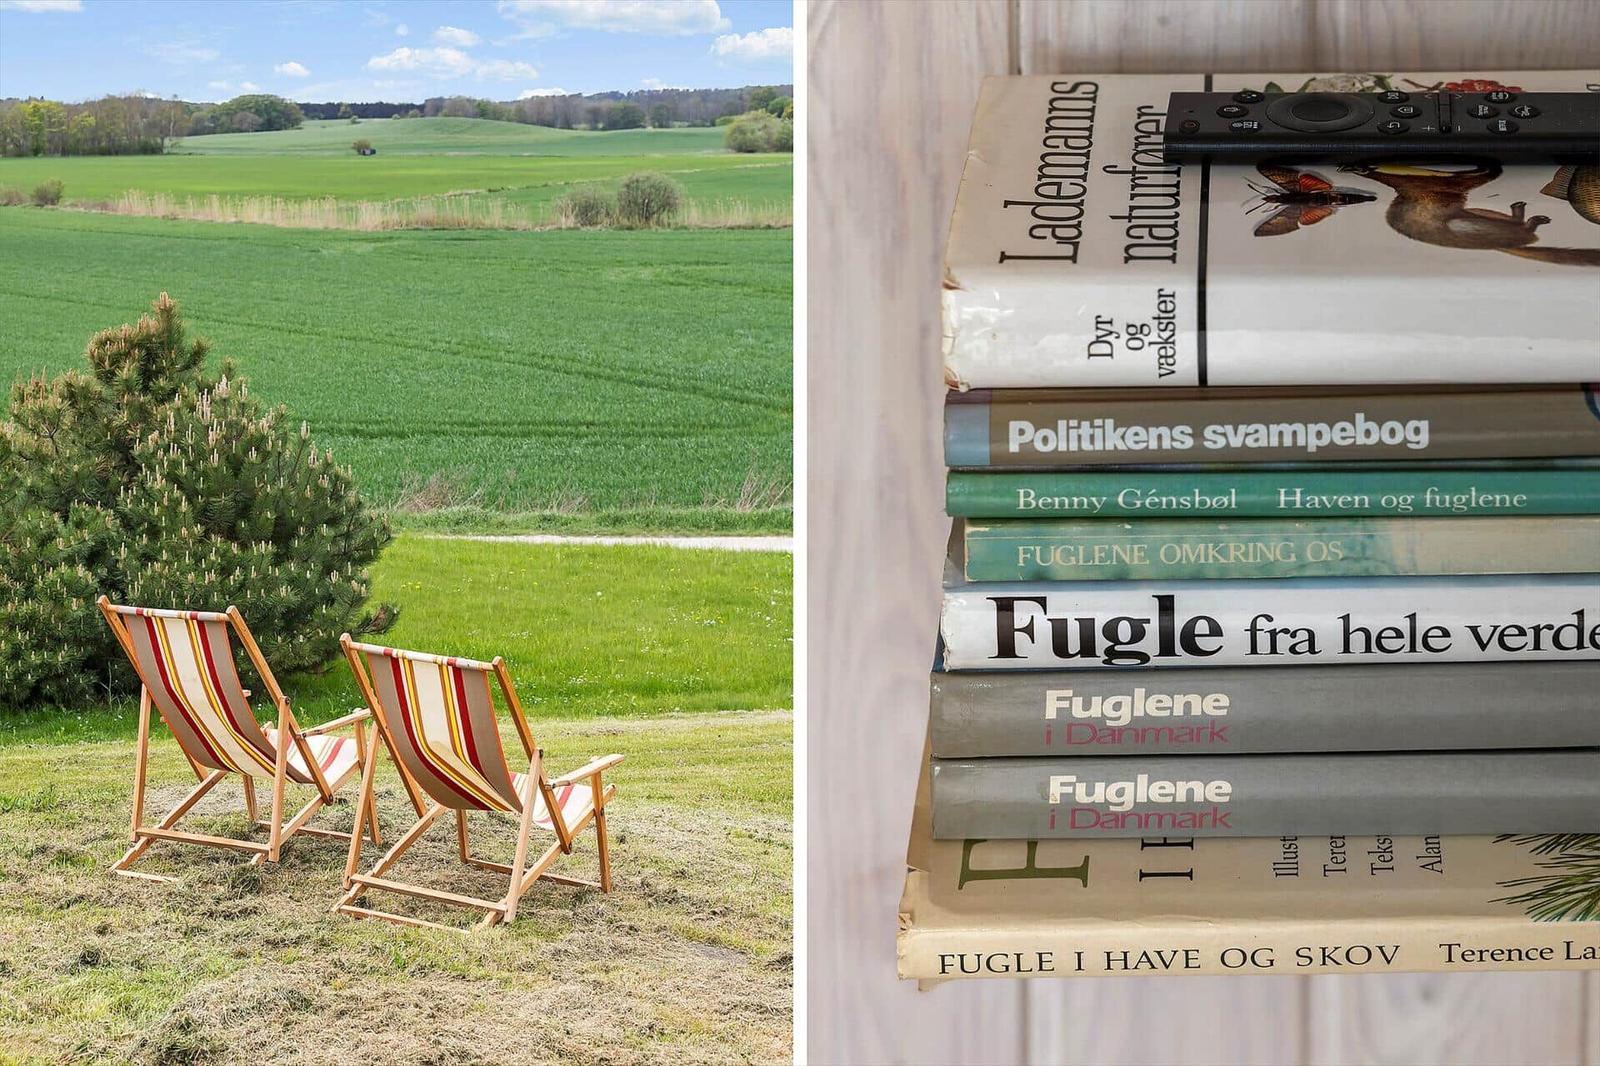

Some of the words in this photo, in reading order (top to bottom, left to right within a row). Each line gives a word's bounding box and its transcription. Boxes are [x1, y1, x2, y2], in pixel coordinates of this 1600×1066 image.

[999, 81, 1099, 264] Lademanns
[1102, 105, 1182, 264] naturfører
[1087, 314, 1121, 360] Dyr
[1125, 322, 1152, 351] og
[1150, 288, 1177, 379] vækster
[1008, 418, 1194, 453] Politikens
[1202, 412, 1430, 452] svampebog
[1016, 488, 1107, 513] Benny
[1117, 487, 1237, 510] Génsbøl
[1277, 487, 1369, 509] Haven
[1380, 494, 1415, 512] og
[1423, 487, 1527, 512] fuglene
[1017, 543, 1149, 567] FUGLENE
[1159, 541, 1296, 564] OMKRING
[1307, 540, 1343, 563] OS
[986, 594, 1224, 666] Fugle
[1243, 613, 1323, 656] fra
[1337, 611, 1453, 655] hele
[1044, 687, 1231, 725] Fuglene
[1043, 723, 1053, 746] i
[1065, 720, 1229, 747] Danmark
[1048, 773, 1233, 810] Fuglene
[1047, 809, 1057, 831] i
[1069, 805, 1233, 831] Danmark
[1367, 834, 1395, 876] Teks
[1416, 834, 1444, 874] Alan
[937, 951, 1055, 975] FUGLE
[1074, 951, 1085, 972] I
[1103, 948, 1201, 971] HAVE
[1220, 947, 1275, 969] OG
[1295, 944, 1402, 968] SKOV
[1439, 943, 1554, 963] Terence
[1563, 940, 1600, 960] La
